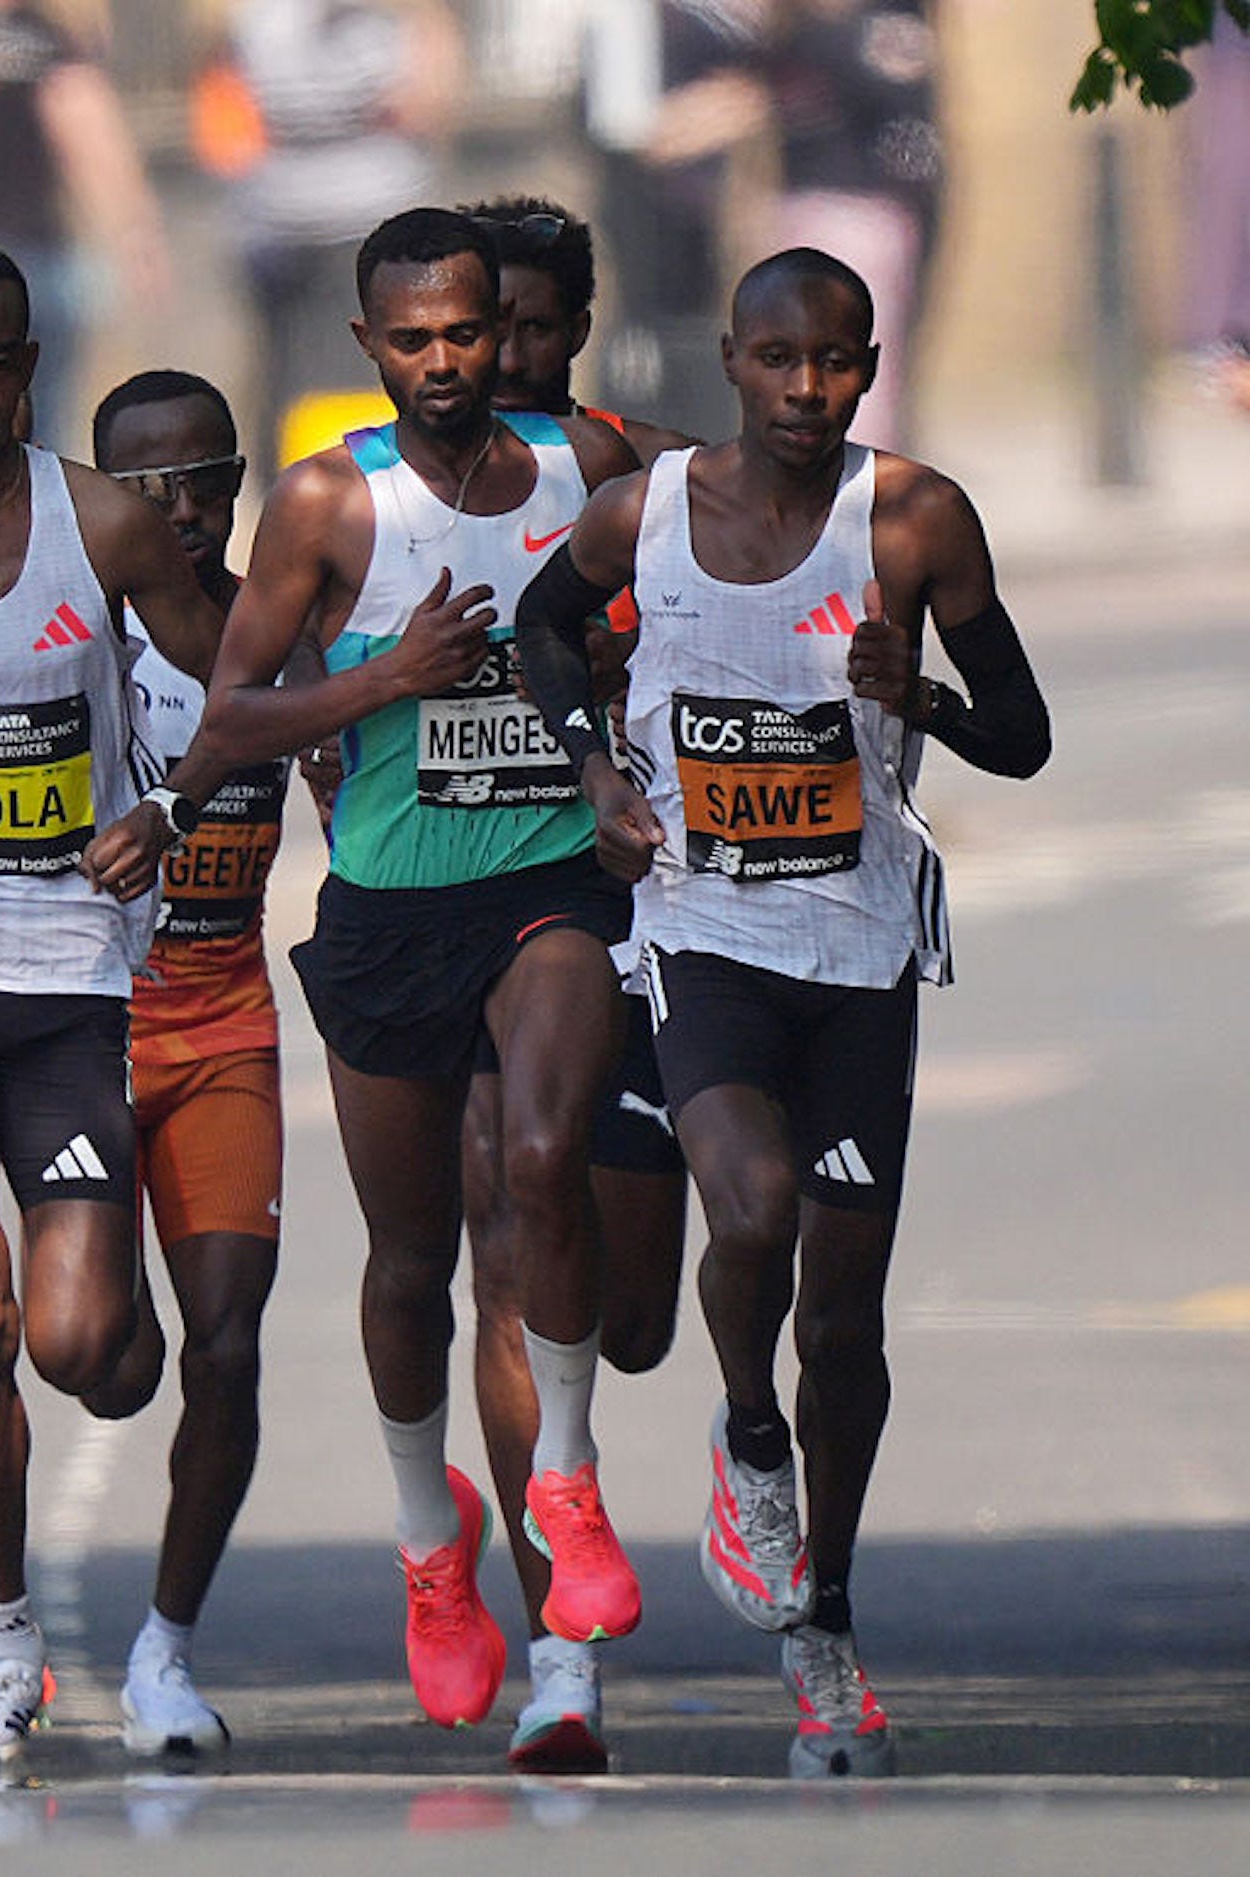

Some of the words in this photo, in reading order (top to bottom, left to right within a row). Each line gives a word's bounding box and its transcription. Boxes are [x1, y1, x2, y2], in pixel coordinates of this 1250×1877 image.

[159, 696, 184, 710] NN
[751, 711, 794, 724] TATA
[430, 715, 559, 760] MENGES
[681, 705, 745, 753] tcs
[751, 741, 817, 755] SERVICES
[529, 784, 578, 801] balan
[706, 783, 833, 829] SAWE
[167, 845, 269, 887] GEEYE
[744, 862, 778, 876] new
